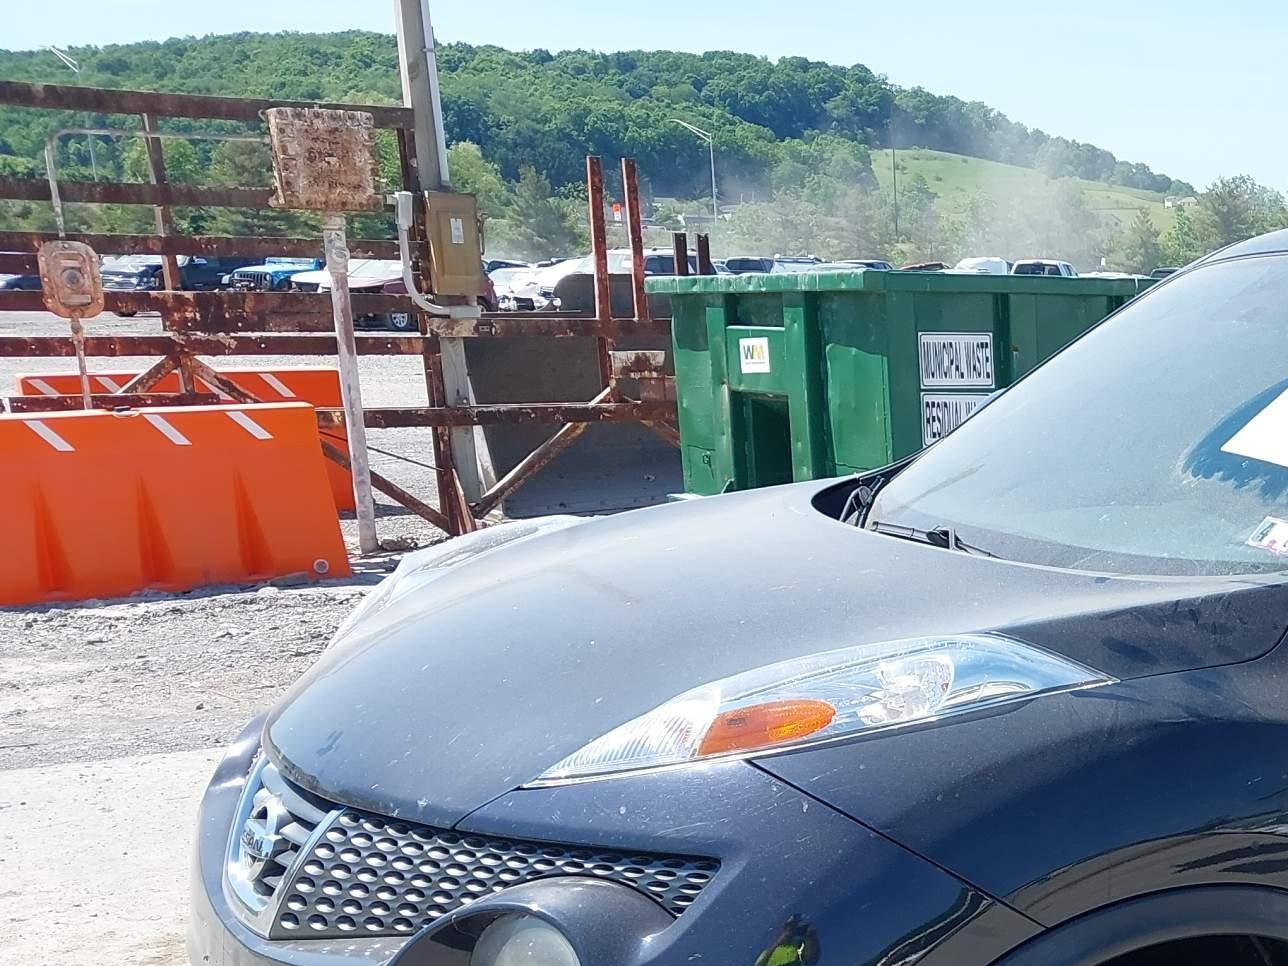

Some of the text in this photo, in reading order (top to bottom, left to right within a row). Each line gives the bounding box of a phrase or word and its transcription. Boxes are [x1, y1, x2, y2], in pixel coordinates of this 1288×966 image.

[742, 344, 764, 360] WM
[922, 341, 991, 379] MUNICIPAL WASTE
